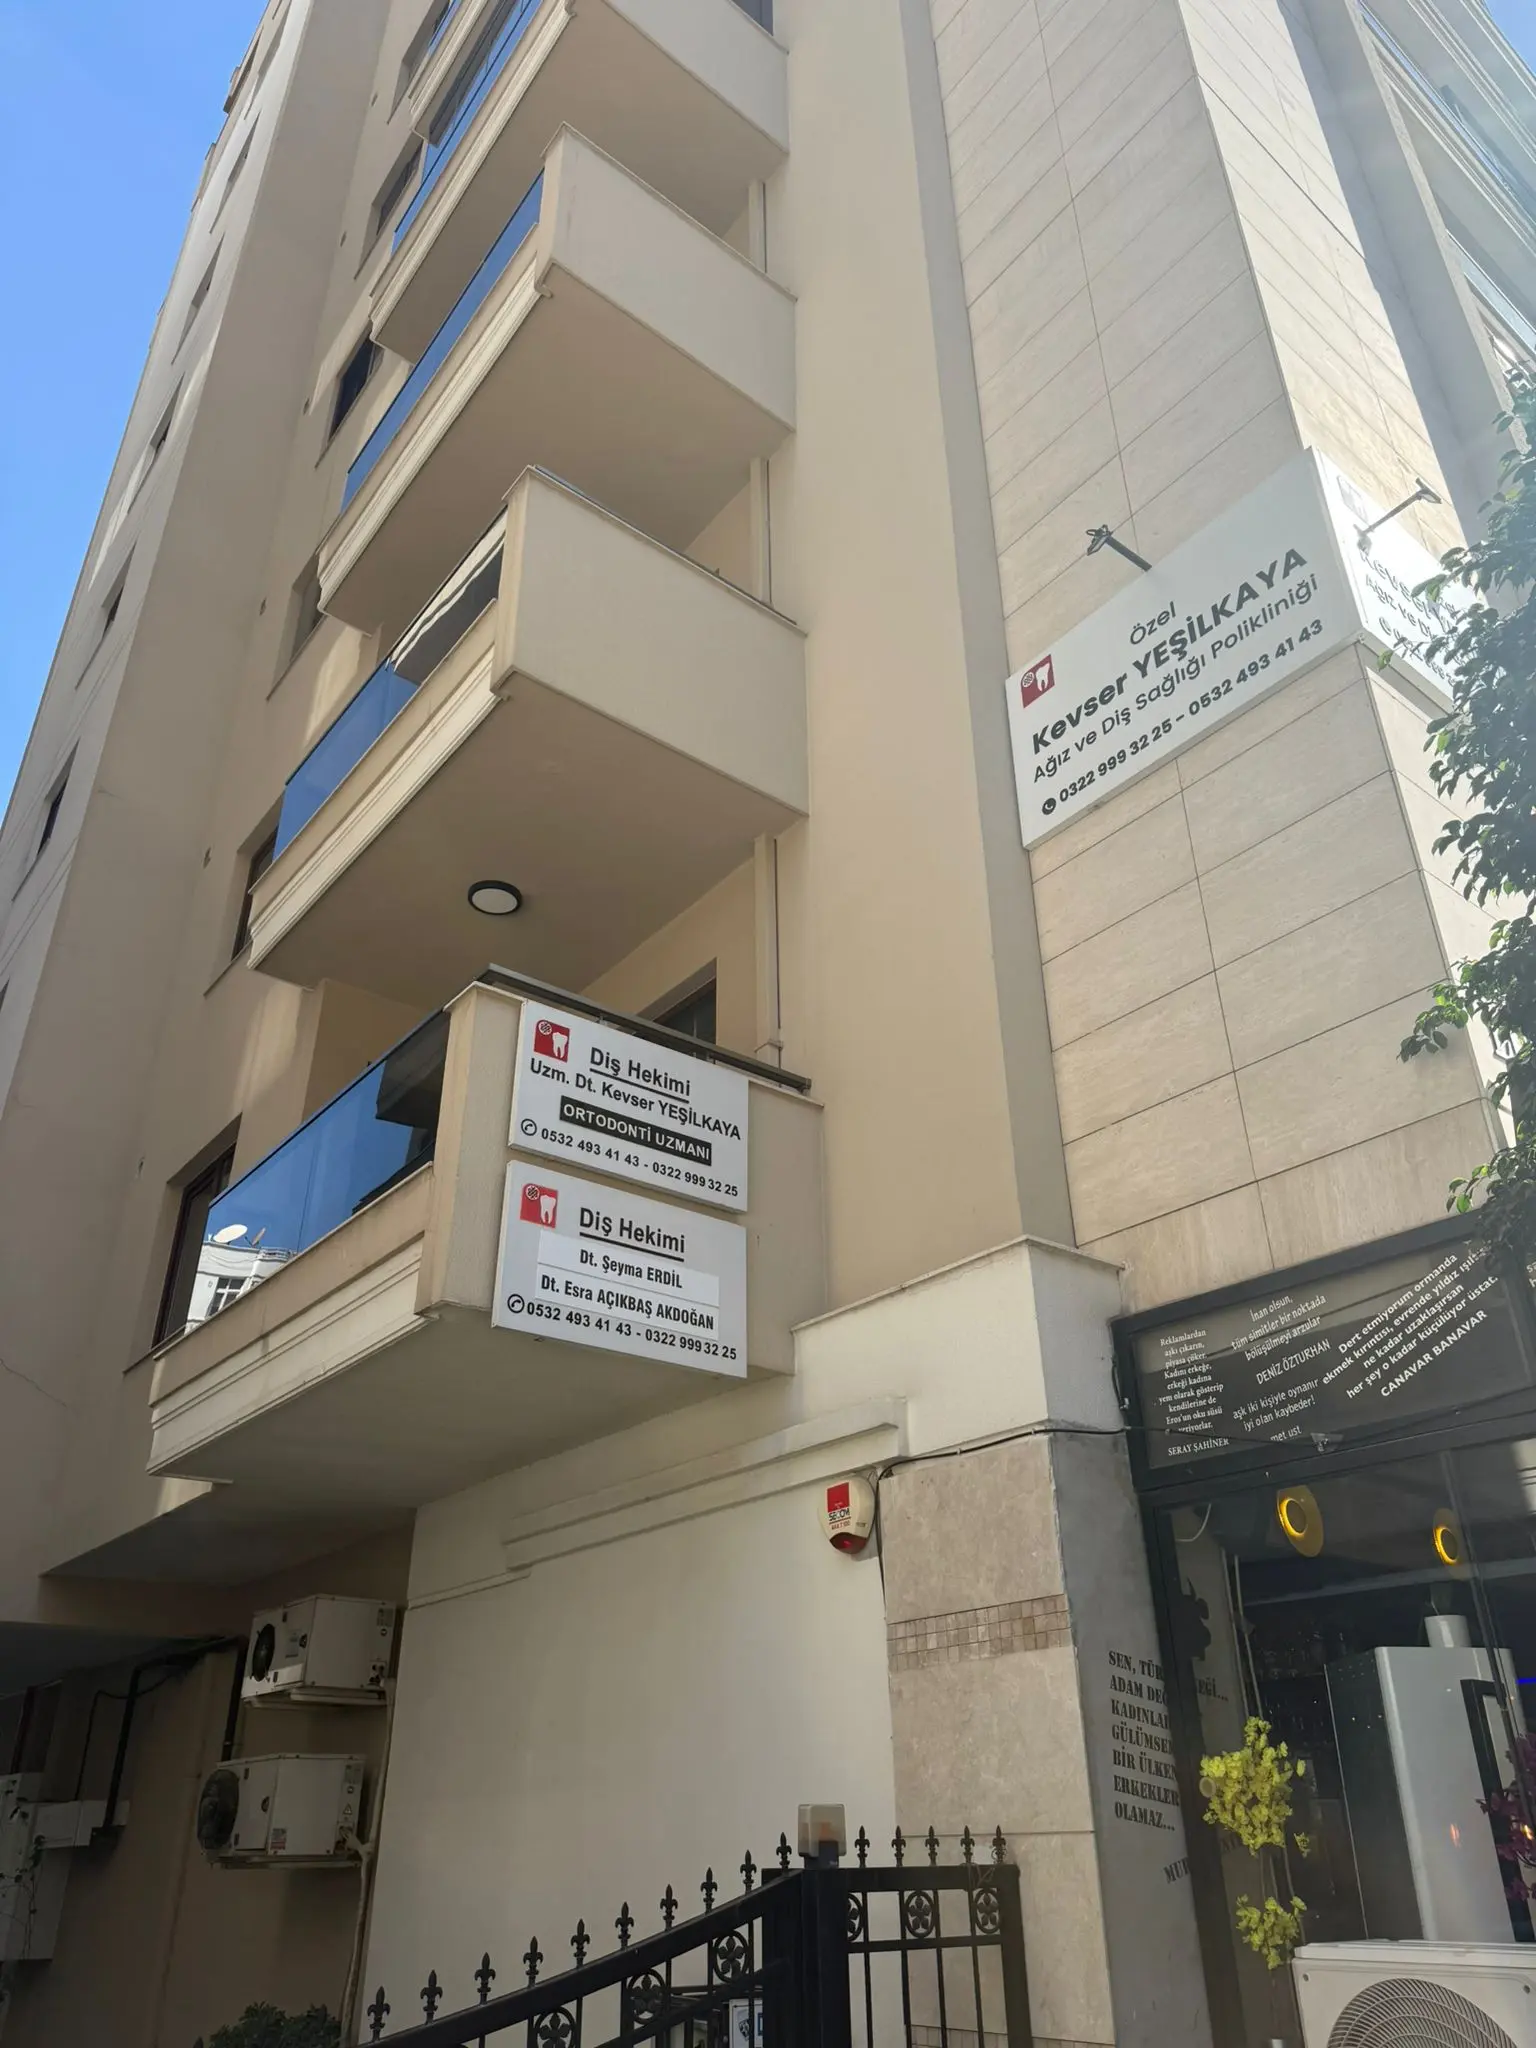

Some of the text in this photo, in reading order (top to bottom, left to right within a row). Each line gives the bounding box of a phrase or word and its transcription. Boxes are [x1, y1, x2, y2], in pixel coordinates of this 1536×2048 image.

[1130, 601, 1176, 644] Özel
[1033, 673, 1127, 755] Kevser
[1132, 548, 1307, 679] YEŞİLKAYA
[1034, 573, 1318, 783] Ağız ve Diş Sağlığı Polikliniği
[1060, 770, 1095, 802] 0322
[1098, 750, 1127, 776] 999
[1130, 734, 1149, 755] 32
[1152, 718, 1172, 741] 25
[1189, 679, 1233, 715] 0532
[1236, 654, 1270, 684] 493
[1275, 637, 1294, 659] 41
[1299, 619, 1323, 643] 43
[590, 1047, 690, 1096] Diş Hekimi
[531, 1058, 741, 1140] Uzm. Dt. Kevser YEŞİLKAYA
[563, 1104, 710, 1161] ORTODONTİ UZMANI
[541, 1128, 573, 1147] 0532
[577, 1138, 601, 1155] 493
[605, 1148, 620, 1161] 41
[624, 1154, 640, 1168] 43
[652, 1162, 681, 1180] 0322
[684, 1172, 706, 1187] 999
[708, 1179, 721, 1192] 32
[724, 1183, 738, 1197] 25
[579, 1207, 685, 1253] Diş Hekimi
[580, 1249, 682, 1288] Dt. Şeyma ERDİL
[541, 1275, 714, 1330] Dt. Esra AÇIKBAŞ AKDOĞAN
[1231, 1295, 1326, 1350] tüm simitler bir noktada
[1250, 1295, 1293, 1322] İnan olsun,
[1338, 1254, 1458, 1354] Dert etmiyorum ormanda
[527, 1302, 561, 1321] 0532
[565, 1311, 590, 1327] 493
[595, 1319, 610, 1331] 41
[615, 1322, 631, 1336] 43
[645, 1329, 675, 1346] 0322
[679, 1338, 701, 1352] 999
[704, 1342, 718, 1354] 32
[721, 1346, 736, 1360] 25
[1160, 1330, 1206, 1346] Reklamlardan
[1245, 1317, 1321, 1361] bölüşülmeyi arzular
[1322, 1356, 1353, 1384] ekmek
[1354, 1327, 1394, 1360] kırıntısı,
[1393, 1293, 1432, 1326] evrende
[1432, 1271, 1459, 1296] yıldız
[1346, 1381, 1363, 1398] her
[1365, 1368, 1381, 1386] şey
[1389, 1337, 1417, 1365] kadar
[1418, 1298, 1467, 1342] küçülüyor
[1467, 1275, 1499, 1301] üstat.
[1363, 1283, 1464, 1368] ne kadar uzaklaşırsan
[1164, 1342, 1204, 1357] aşkı çıkarın,
[1164, 1363, 1212, 1379] Kadını erkeğe,
[1165, 1356, 1185, 1369] piyasa
[1256, 1338, 1331, 1384] DENİZ ÖZTURHAN
[1380, 1309, 1488, 1397] CANAVAR BANAVAR
[1159, 1382, 1224, 1406] yem olarak gösterip
[1167, 1375, 1212, 1390] erkeği kadına
[1169, 1396, 1216, 1412] kendilerine de
[1233, 1379, 1319, 1420] aşk iki kişiyle oynanır
[1193, 1411, 1205, 1419] oku
[1207, 1406, 1222, 1416] süsü
[1243, 1395, 1316, 1432] iyi olan kaybeder!
[1168, 1438, 1229, 1456] SERAY ŞAHİNER
[1109, 1650, 1136, 1674] SEN,
[1110, 1675, 1143, 1698] ADAM
[1113, 1746, 1135, 1770] BİR
[1115, 1802, 1175, 1831] OLAMAZ...
